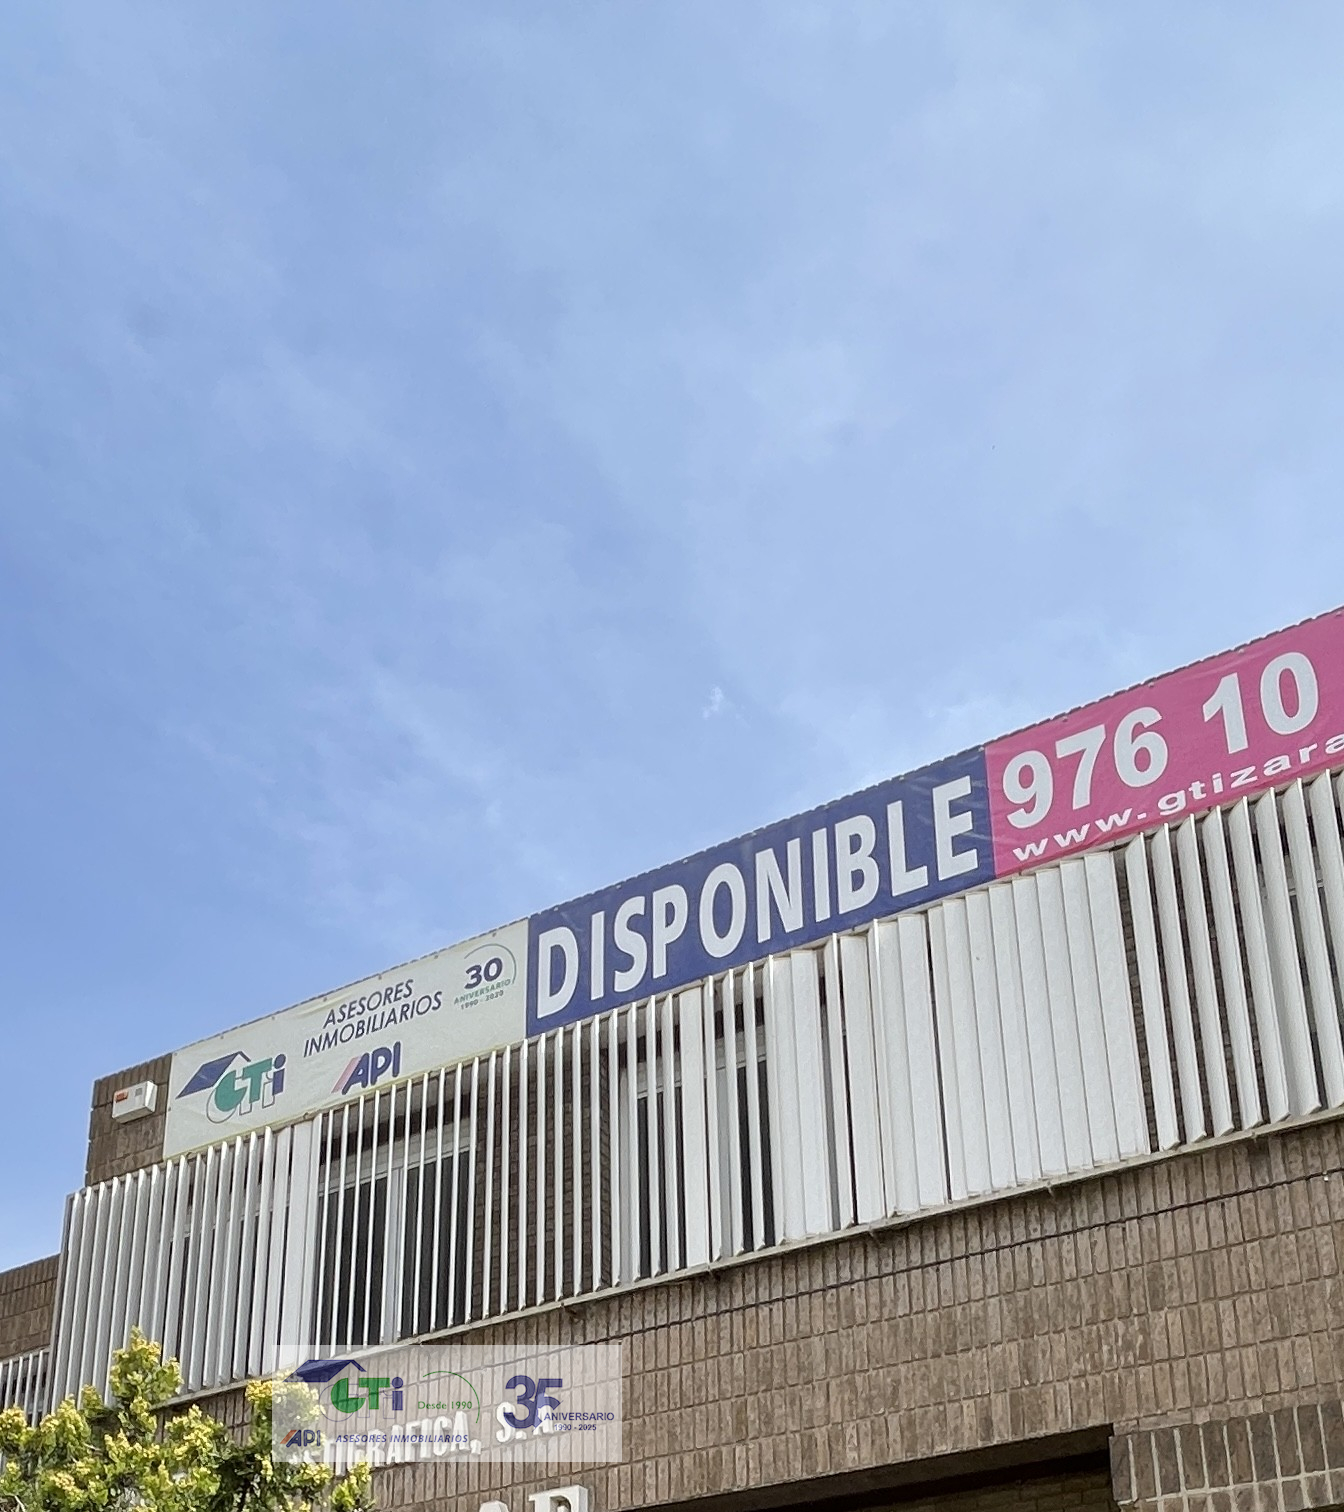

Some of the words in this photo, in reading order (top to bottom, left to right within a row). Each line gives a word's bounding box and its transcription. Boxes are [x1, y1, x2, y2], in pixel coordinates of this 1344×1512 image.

[1002, 706, 1168, 830] 976
[1203, 652, 1319, 755] 10
[536, 774, 979, 1020] DISPONIBLE
[454, 979, 511, 1004] ANIVERSARIO
[464, 957, 503, 989] 30
[303, 991, 443, 1058] INMOBILIARIOS
[323, 979, 414, 1029] ASESORES
[341, 1042, 402, 1096] API
